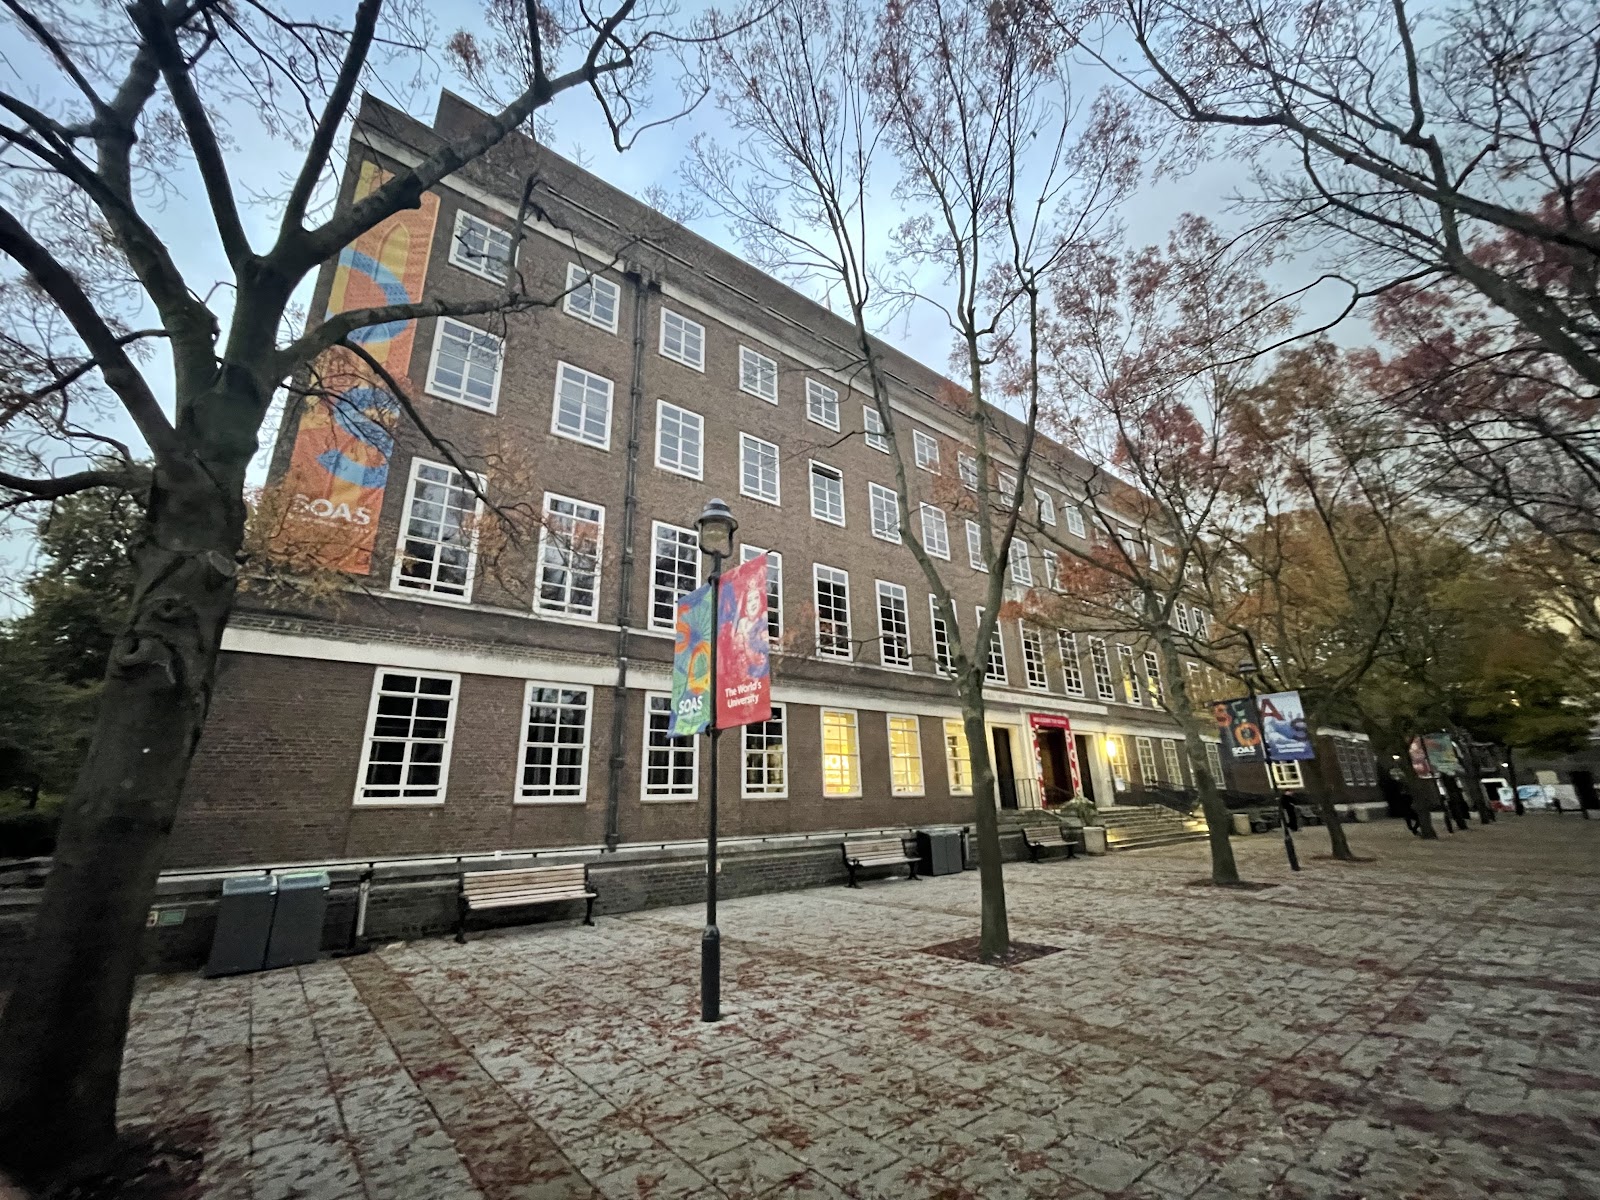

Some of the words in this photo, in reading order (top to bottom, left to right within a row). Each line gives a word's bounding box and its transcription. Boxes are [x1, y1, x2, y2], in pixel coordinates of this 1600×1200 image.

[292, 493, 371, 526] SOAS
[725, 687, 737, 698] The
[737, 680, 762, 695] World's
[678, 695, 703, 715] SOAS
[727, 693, 760, 708] University
[1232, 746, 1256, 754] SOAS
